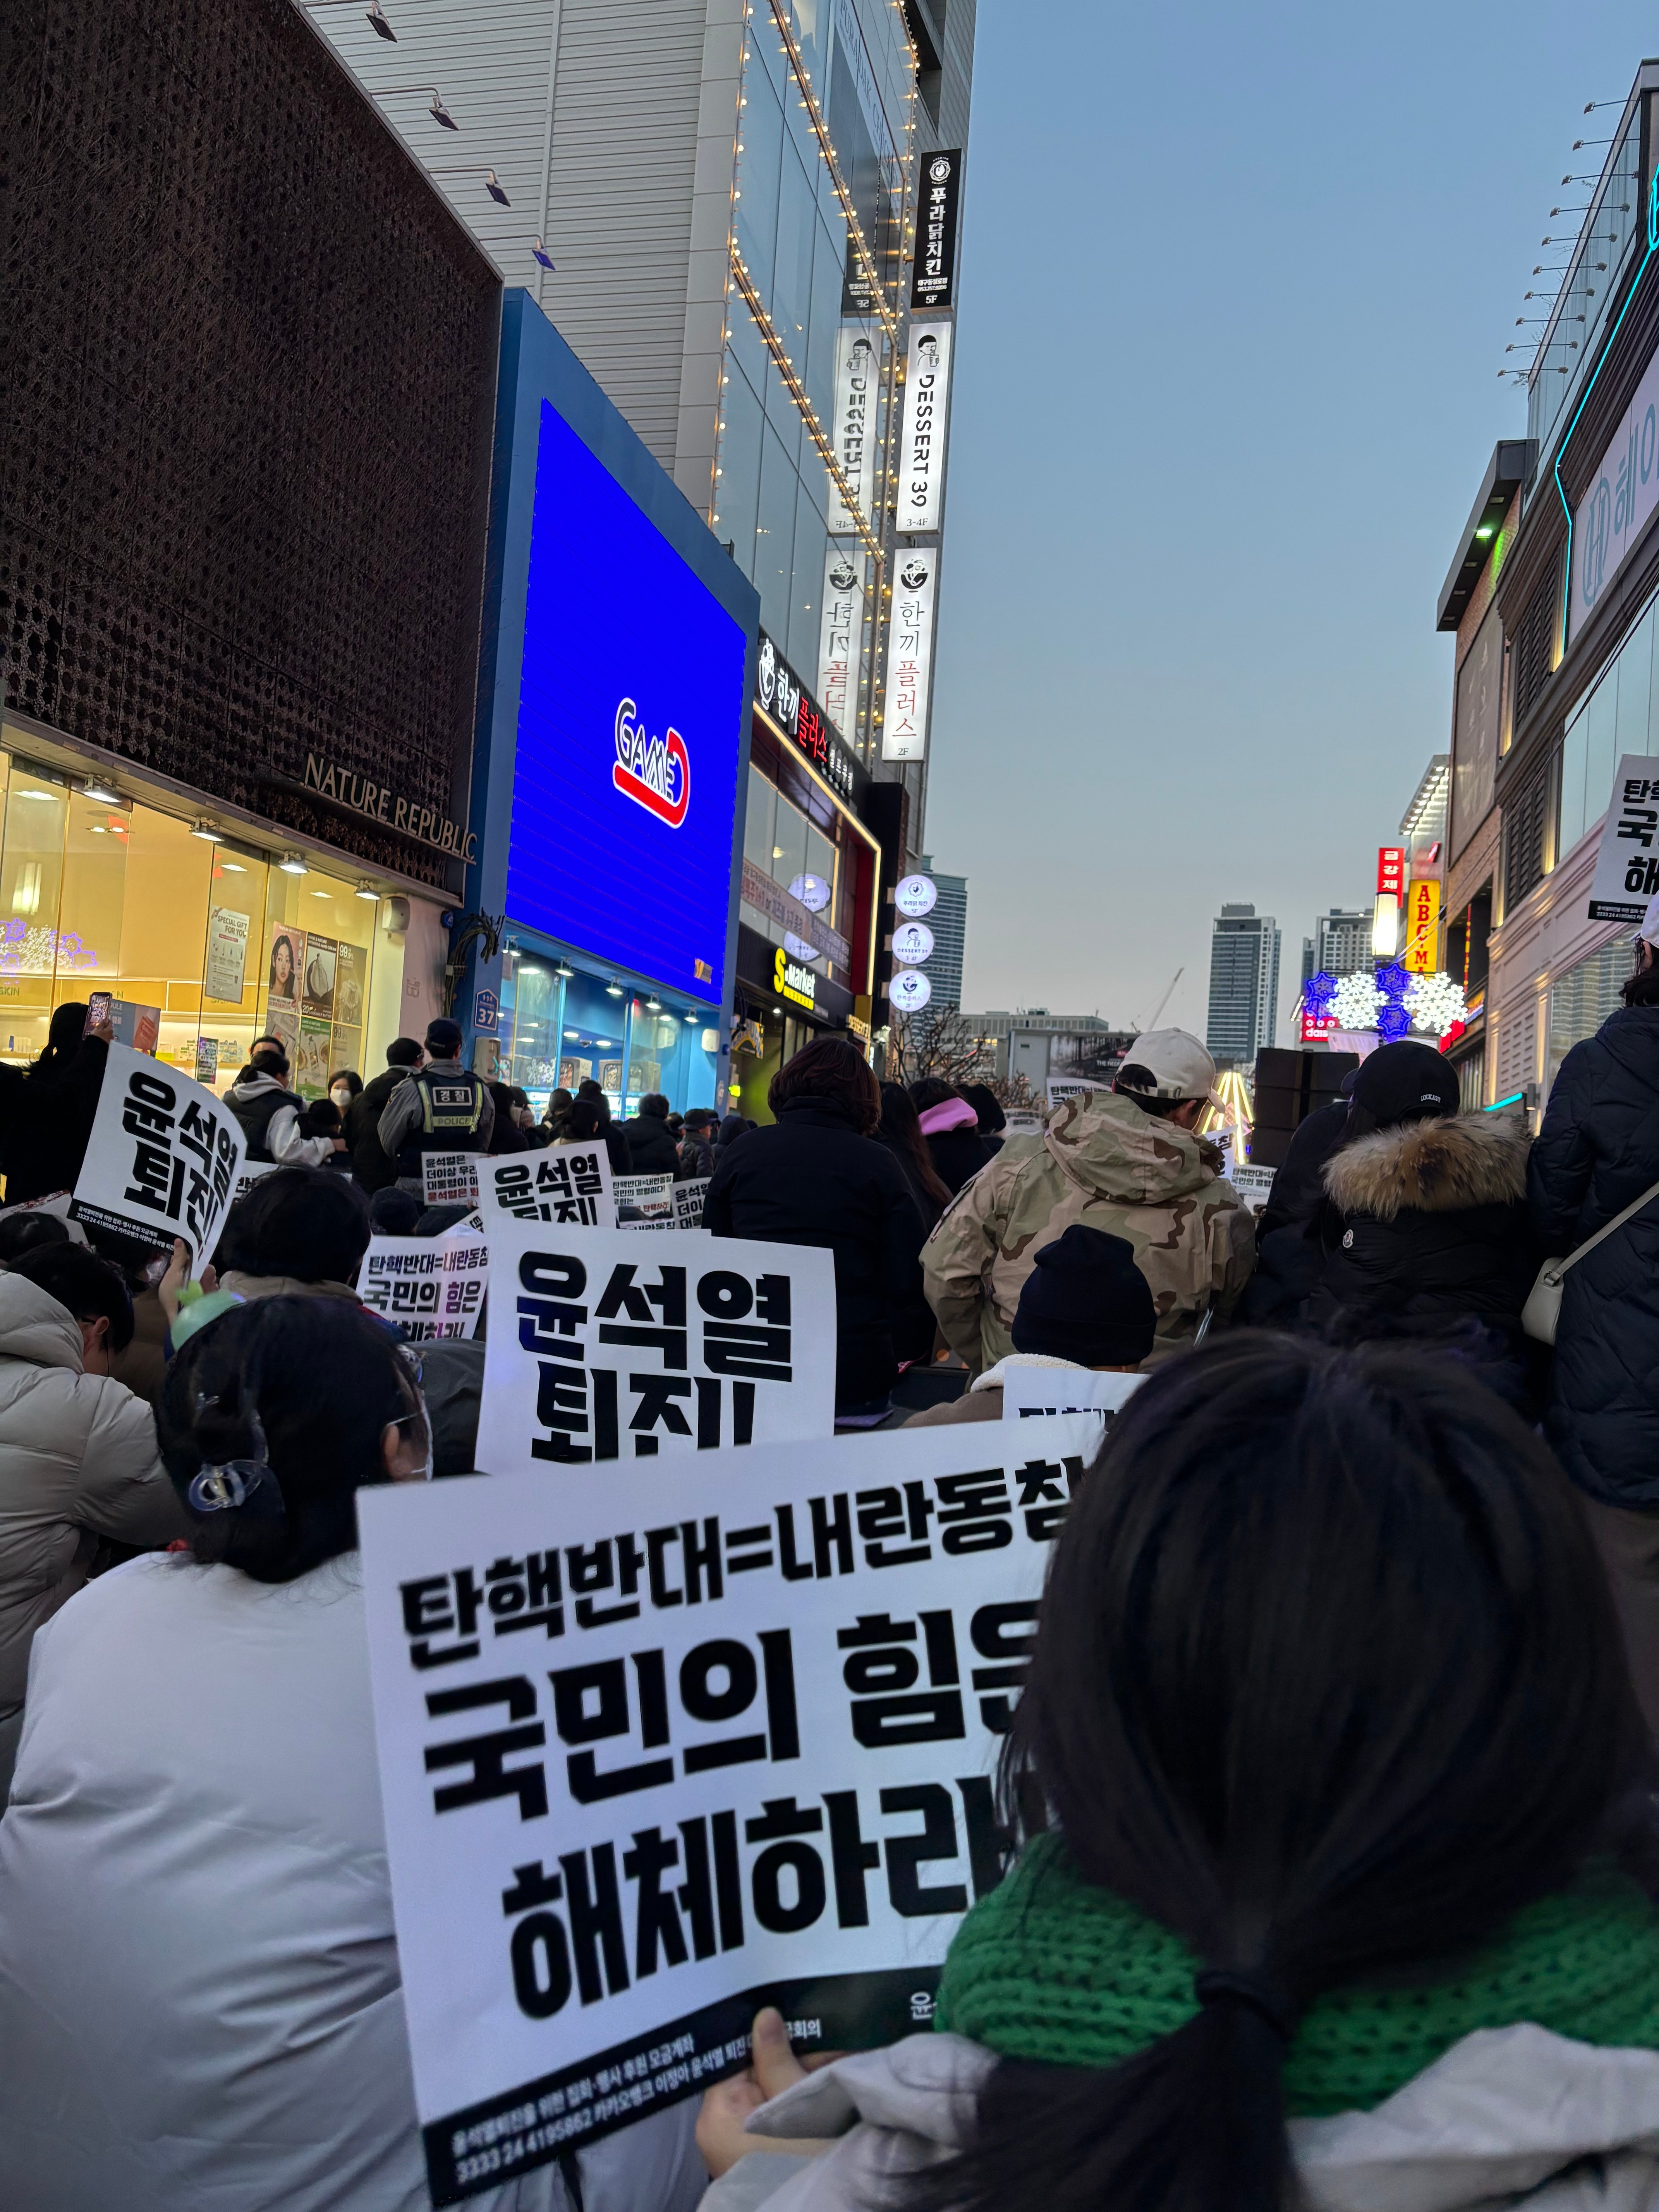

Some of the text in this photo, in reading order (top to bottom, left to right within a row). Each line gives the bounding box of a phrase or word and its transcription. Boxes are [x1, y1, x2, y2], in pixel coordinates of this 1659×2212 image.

[925, 187, 946, 276] 푸라닭치킨
[925, 295, 938, 304] 5F
[911, 374, 935, 507] DESSERT 39
[906, 517, 929, 527] 3-4F
[892, 601, 925, 737] 한끼플러스
[777, 667, 827, 762] 한끼플러스
[898, 747, 909, 756] 2F
[304, 751, 478, 861] NATURE REPUBLIC
[1382, 851, 1399, 890] 금강제
[218, 915, 247, 930] SPECIAL GIFT
[225, 925, 247, 938] FOR YOU
[478, 1008, 494, 1025] 37
[1305, 1027, 1329, 1038] dais
[438, 1117, 471, 1125] POLICE
[494, 1153, 603, 1208] 윤석열
[76, 1212, 89, 1221] 3333
[364, 1279, 481, 1314] 국민의 힘은
[517, 1250, 792, 1382] 윤석열
[423, 1626, 800, 1824] 국민의
[455, 2148, 500, 2185] 3333
[502, 2137, 525, 2166] 24
[691, 2049, 726, 2077] 윤석열
